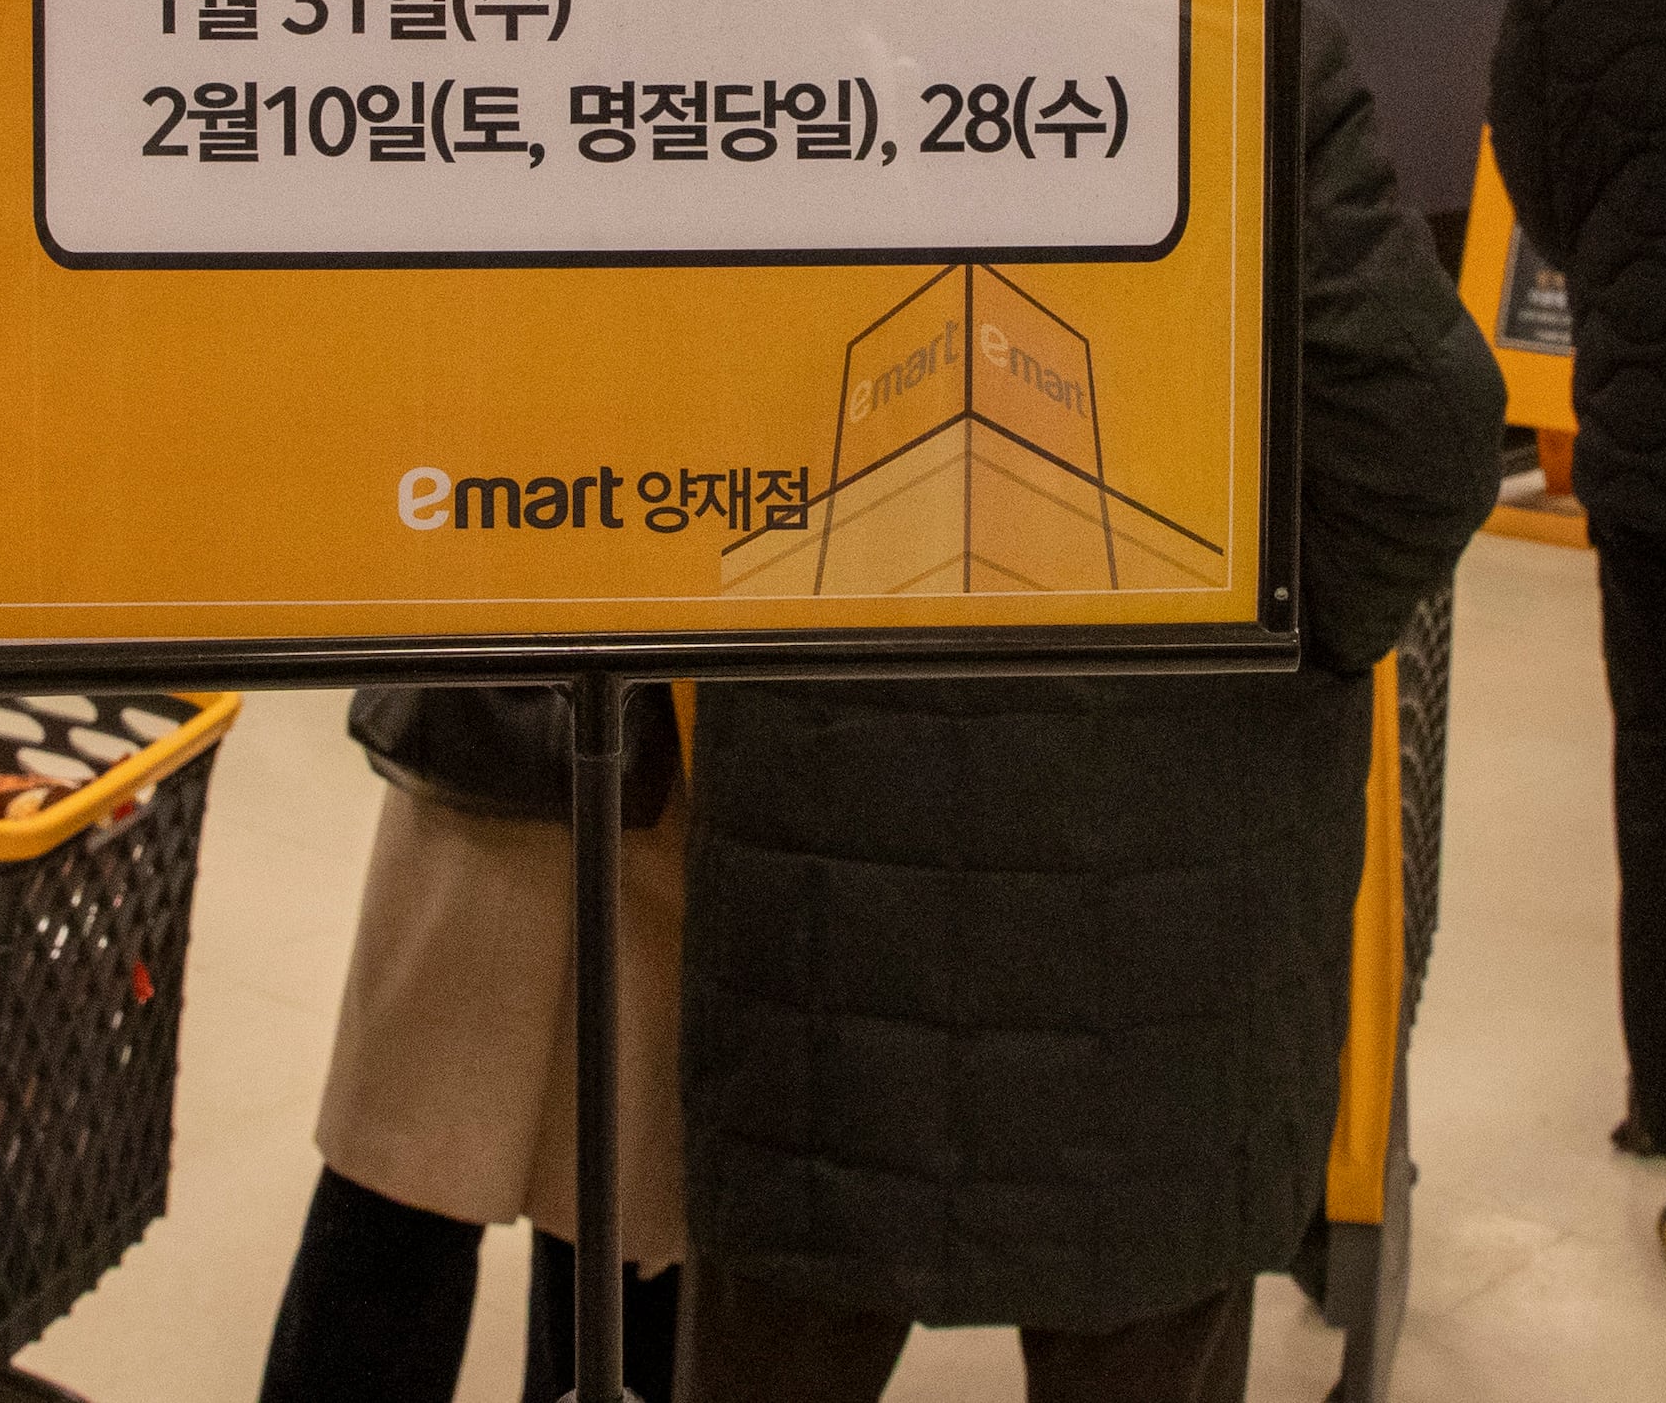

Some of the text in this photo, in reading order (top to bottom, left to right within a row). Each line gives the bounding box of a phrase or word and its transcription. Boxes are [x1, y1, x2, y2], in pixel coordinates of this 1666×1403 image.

[143, 76, 1128, 167] 2월10일(토, 명절당일), 28(수)
[847, 315, 959, 425] emart
[979, 320, 1088, 420] emart
[397, 463, 811, 535] emart 양재점
